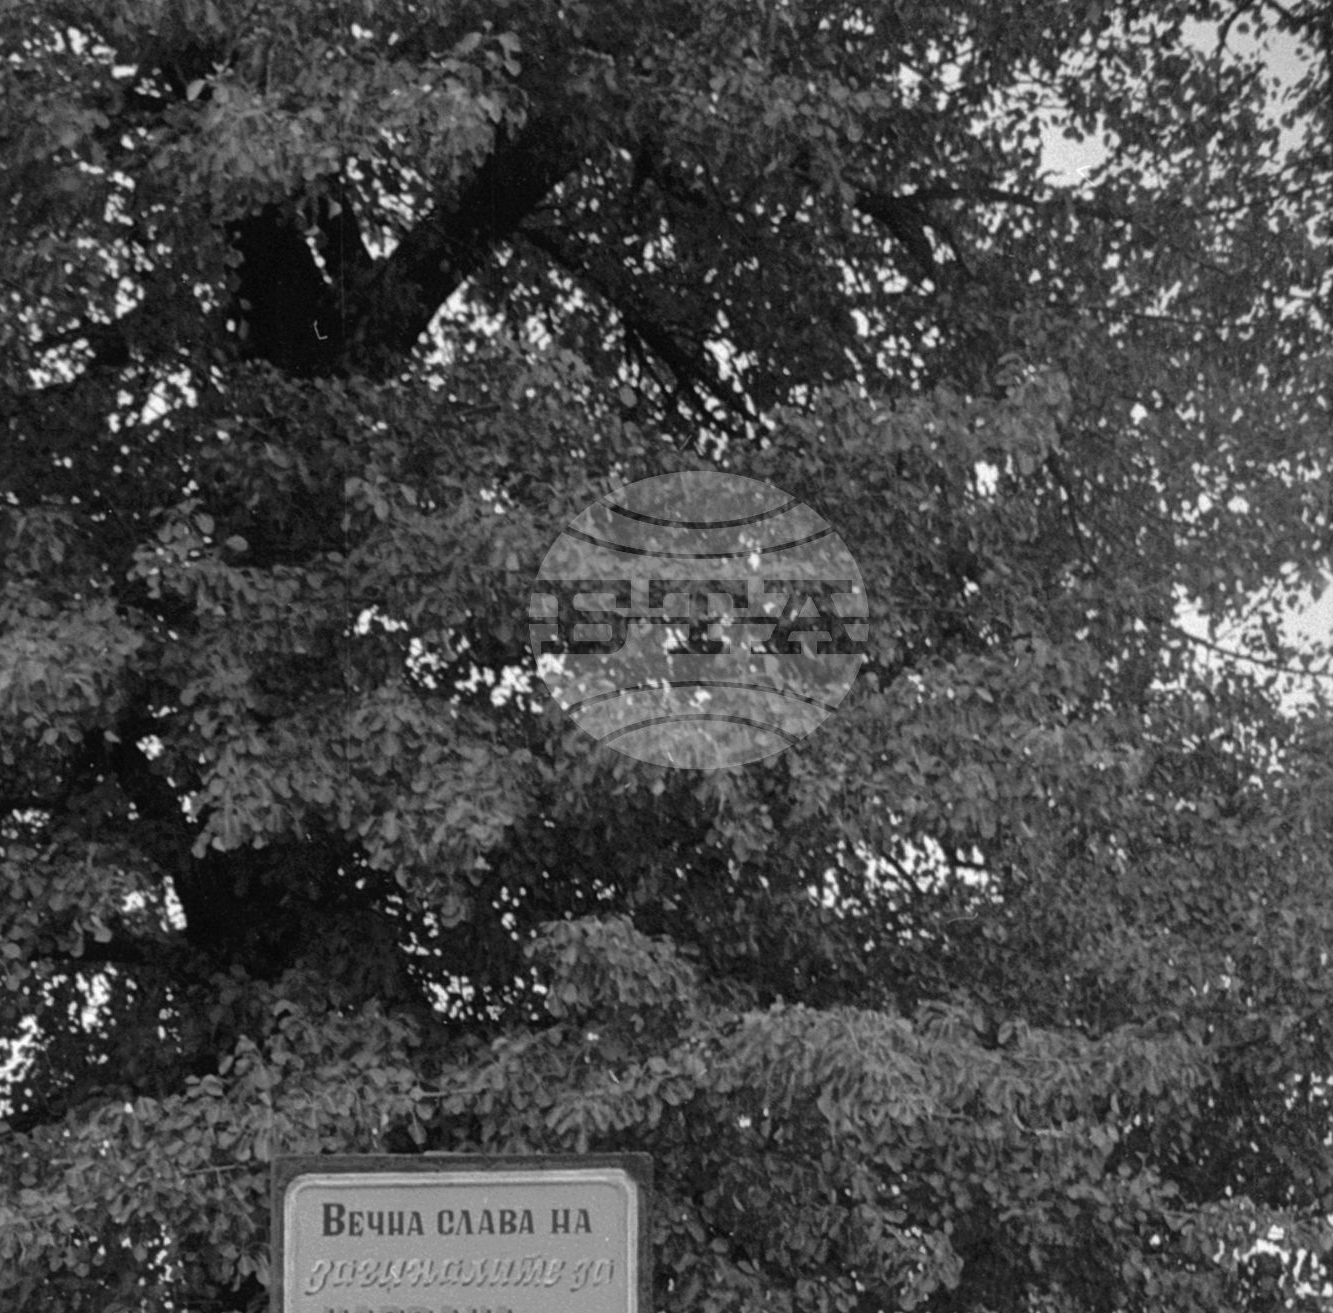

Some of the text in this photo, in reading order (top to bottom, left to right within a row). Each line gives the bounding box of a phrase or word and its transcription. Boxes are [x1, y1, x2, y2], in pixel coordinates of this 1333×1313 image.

[437, 1209, 534, 1236] СЛАВА
[550, 1208, 592, 1235] НА
[570, 1257, 615, 1292] за
